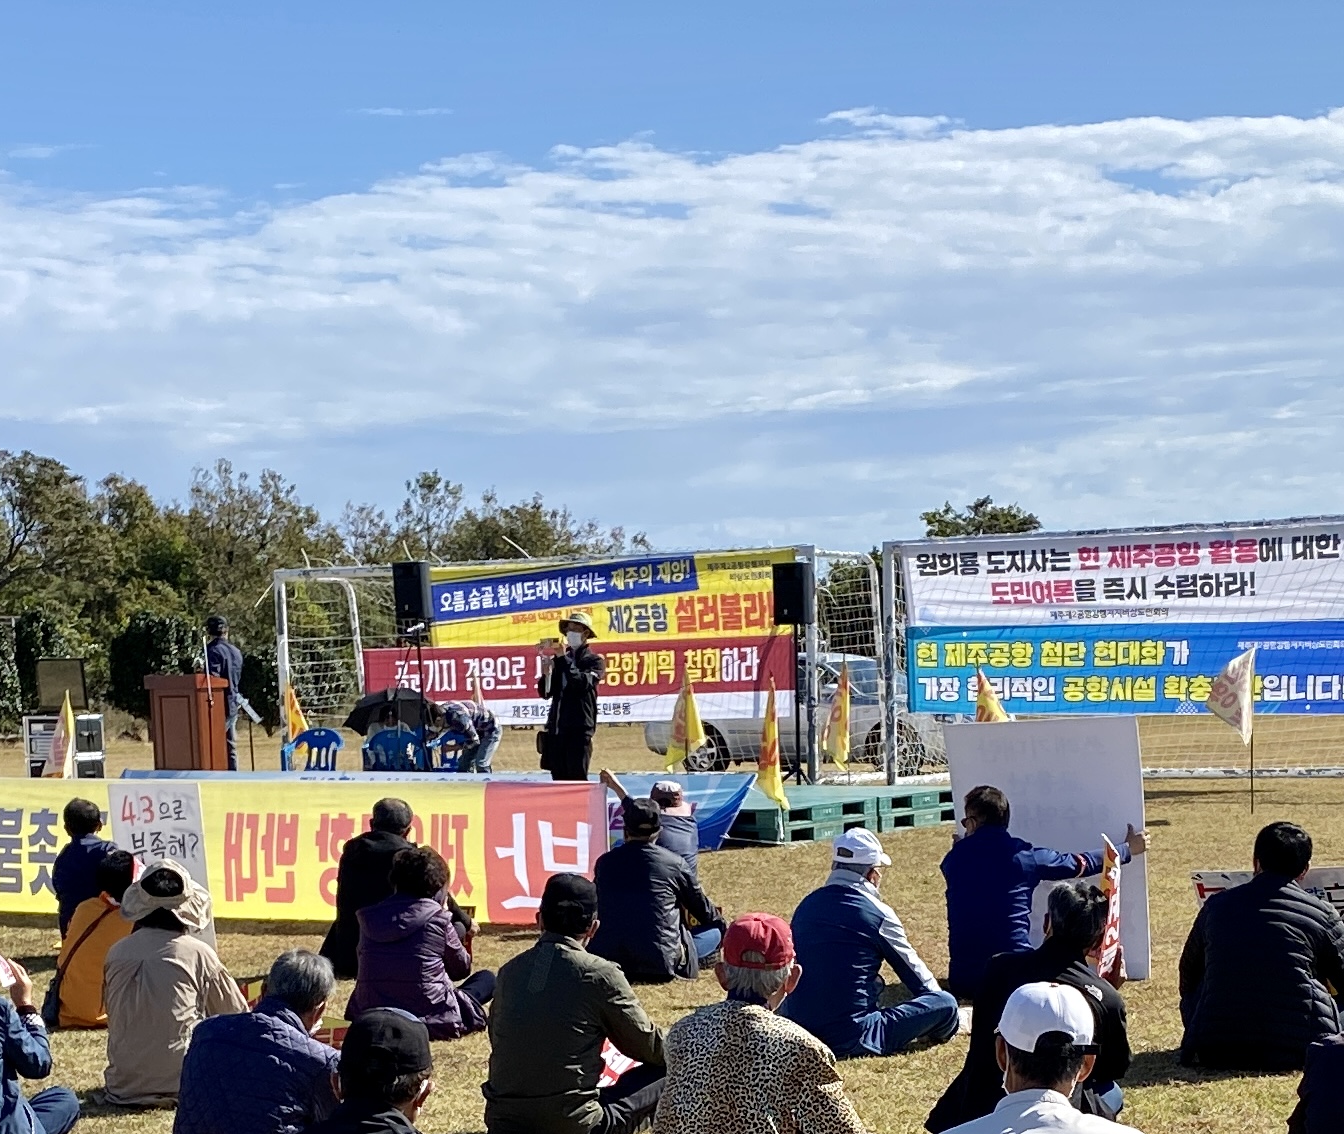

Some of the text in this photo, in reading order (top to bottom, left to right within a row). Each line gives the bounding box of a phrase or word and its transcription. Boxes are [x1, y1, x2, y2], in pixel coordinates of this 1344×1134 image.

[916, 533, 1342, 577] 원희룡 도지사는 현 제주공항 활용에 대한
[439, 558, 691, 613] 오름,숨골,철새도래지 망치는 제주의 재앙!
[991, 571, 1256, 605] 도민여론을 즉시 수렴하라!
[607, 602, 669, 634] 제2공항
[684, 645, 760, 684] 철회하라
[915, 639, 1191, 668] 현 제주공항 첨단 현대화가
[463, 655, 528, 692] 겸용으로
[917, 675, 962, 703] 가장
[1062, 674, 1157, 703] 공항시설
[130, 830, 200, 861] 부족해?
